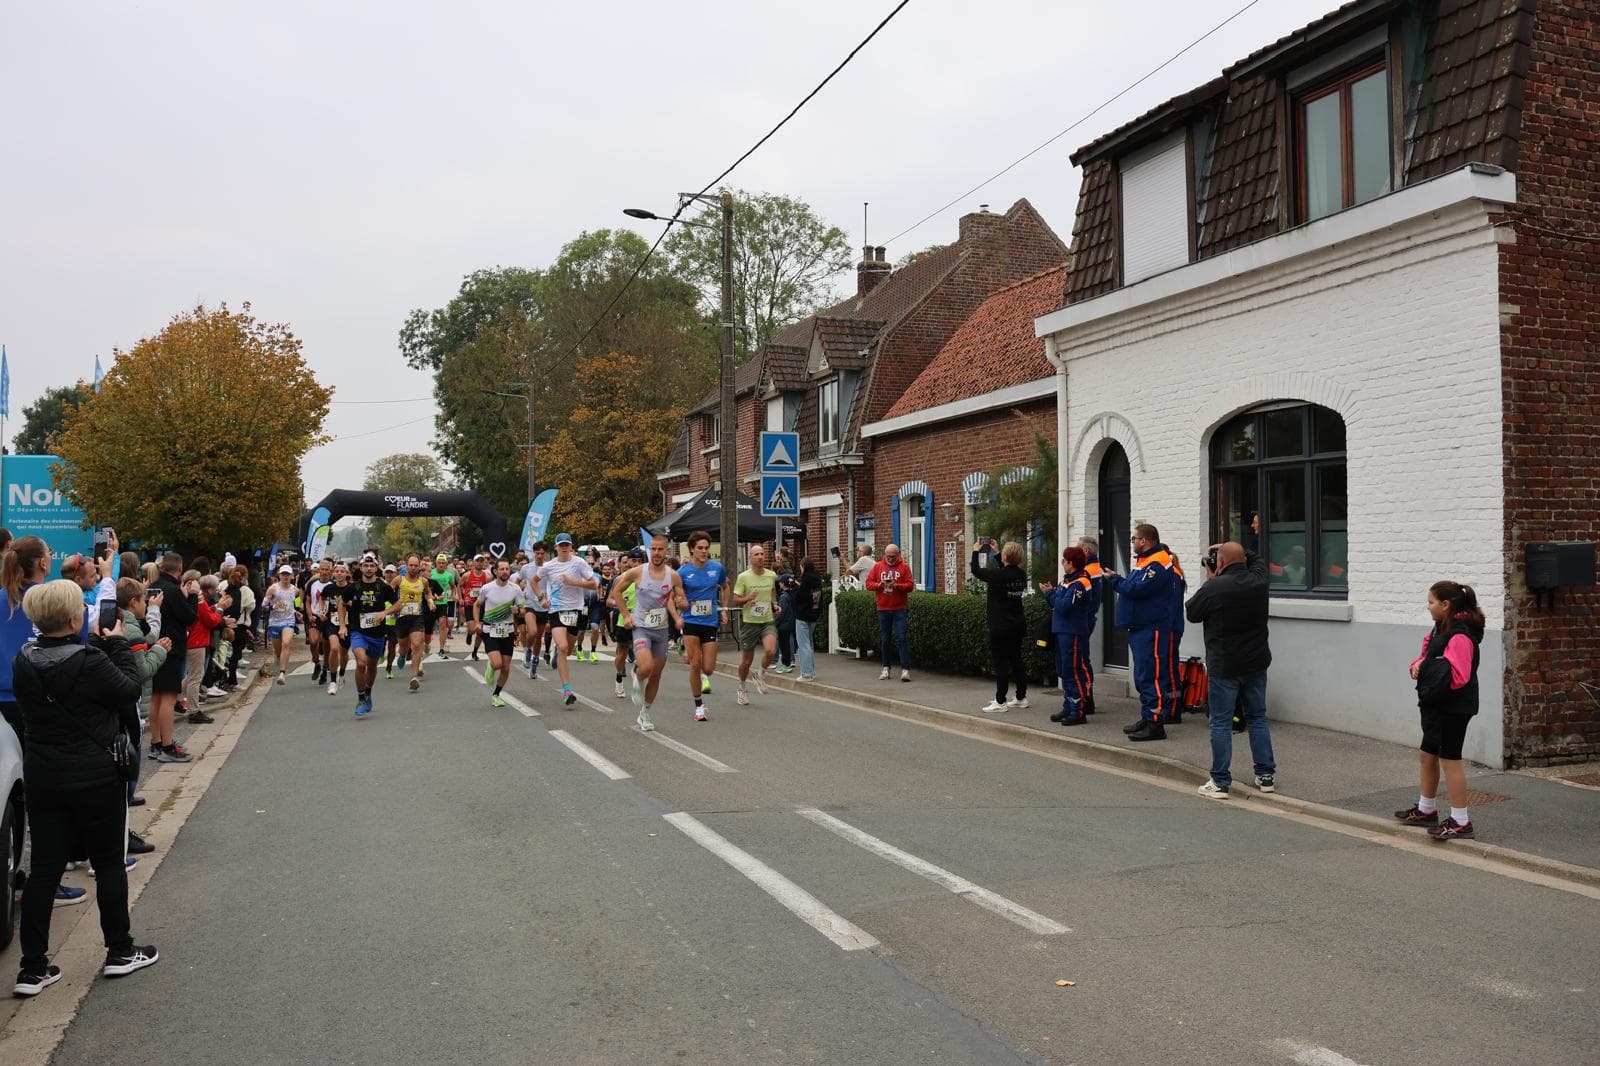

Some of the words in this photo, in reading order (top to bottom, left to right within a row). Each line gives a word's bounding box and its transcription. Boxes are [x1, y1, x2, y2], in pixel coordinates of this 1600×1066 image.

[9, 483, 62, 506] Nor
[880, 570, 901, 582] GAP
[650, 614, 662, 624] 275
